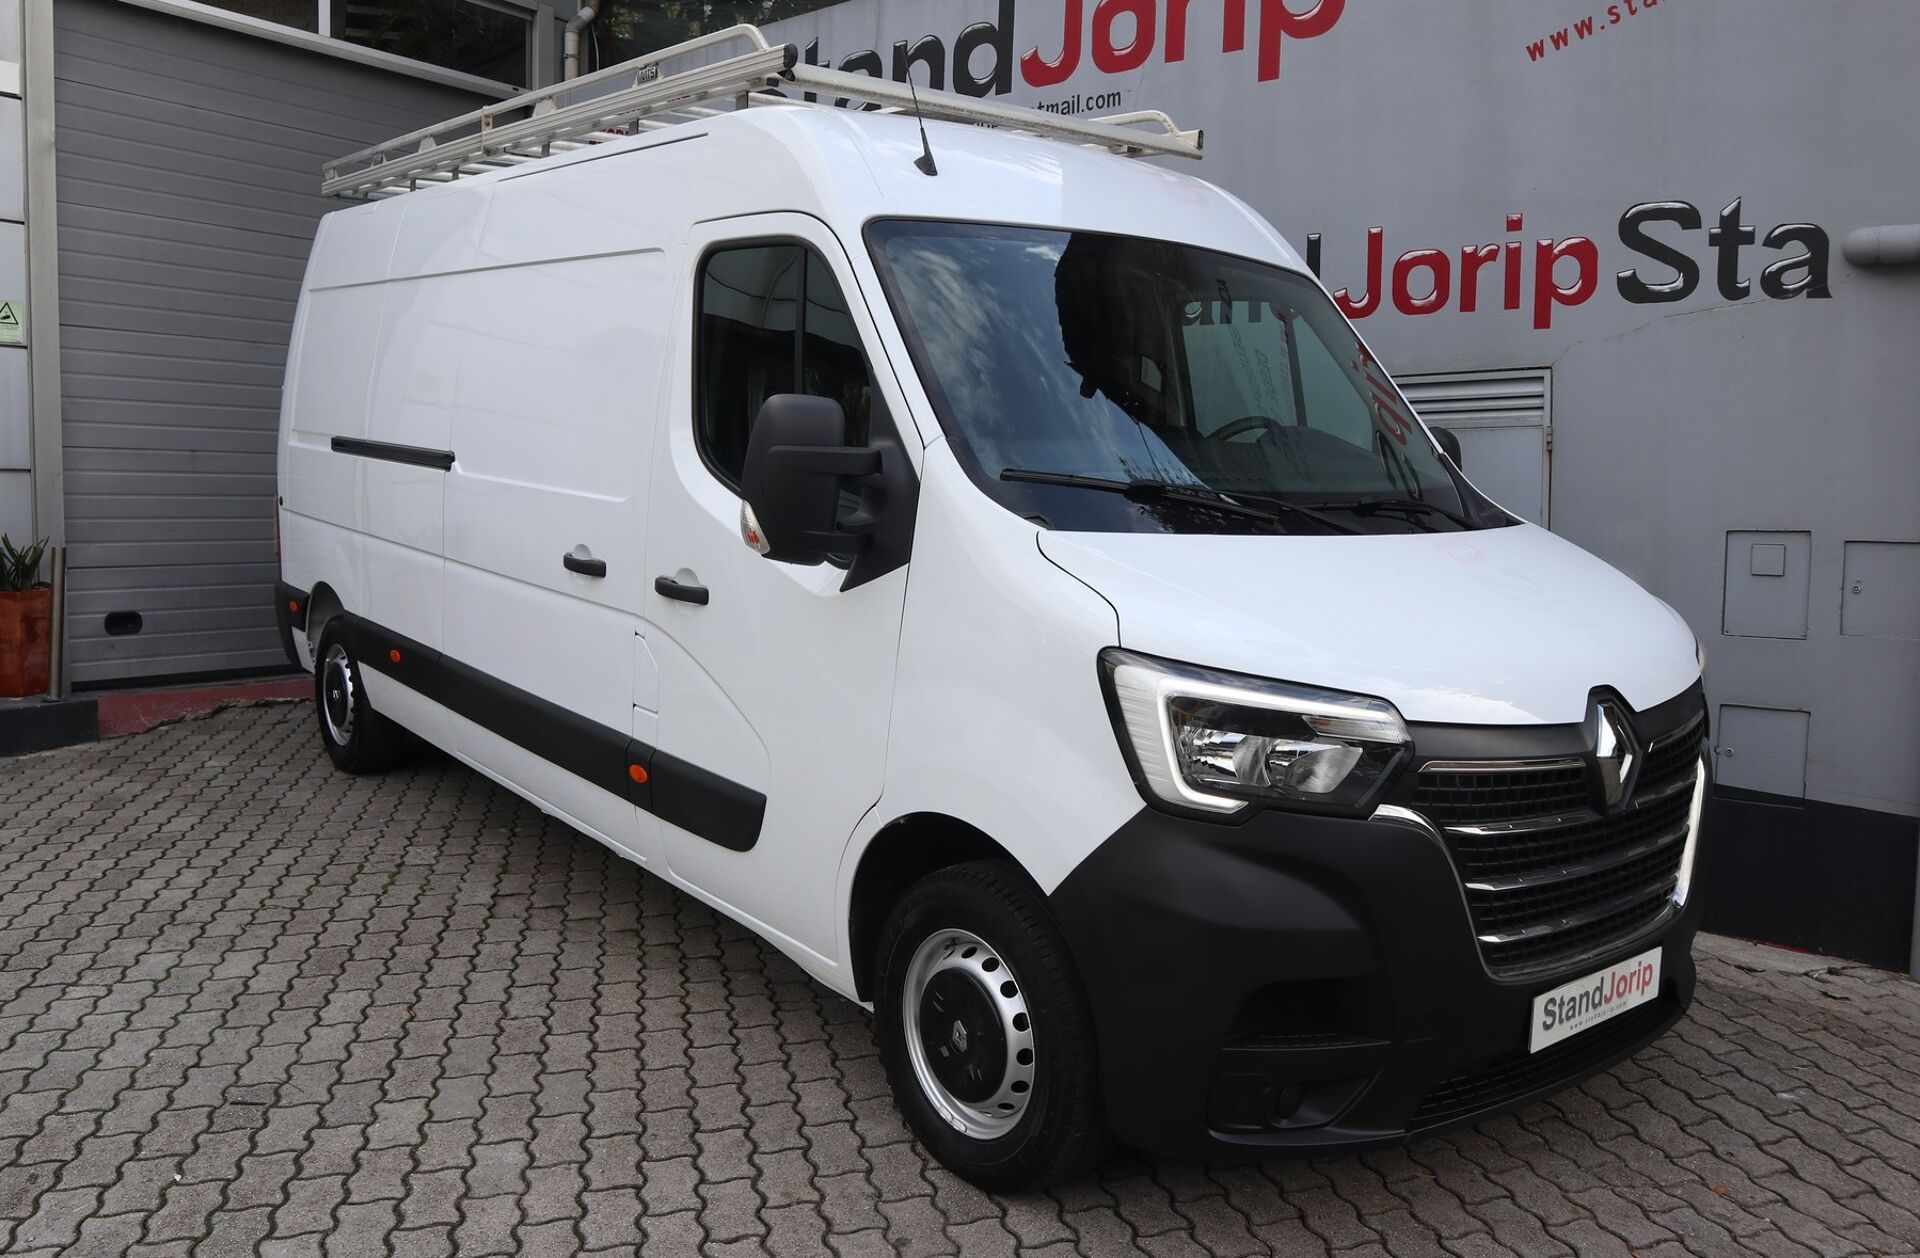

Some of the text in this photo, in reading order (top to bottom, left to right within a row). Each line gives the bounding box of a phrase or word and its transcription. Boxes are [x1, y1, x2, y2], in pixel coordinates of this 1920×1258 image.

[756, 0, 1346, 112] tandJorip
[1031, 91, 1121, 115] tmail.com
[1307, 213, 1599, 330] Jorip
